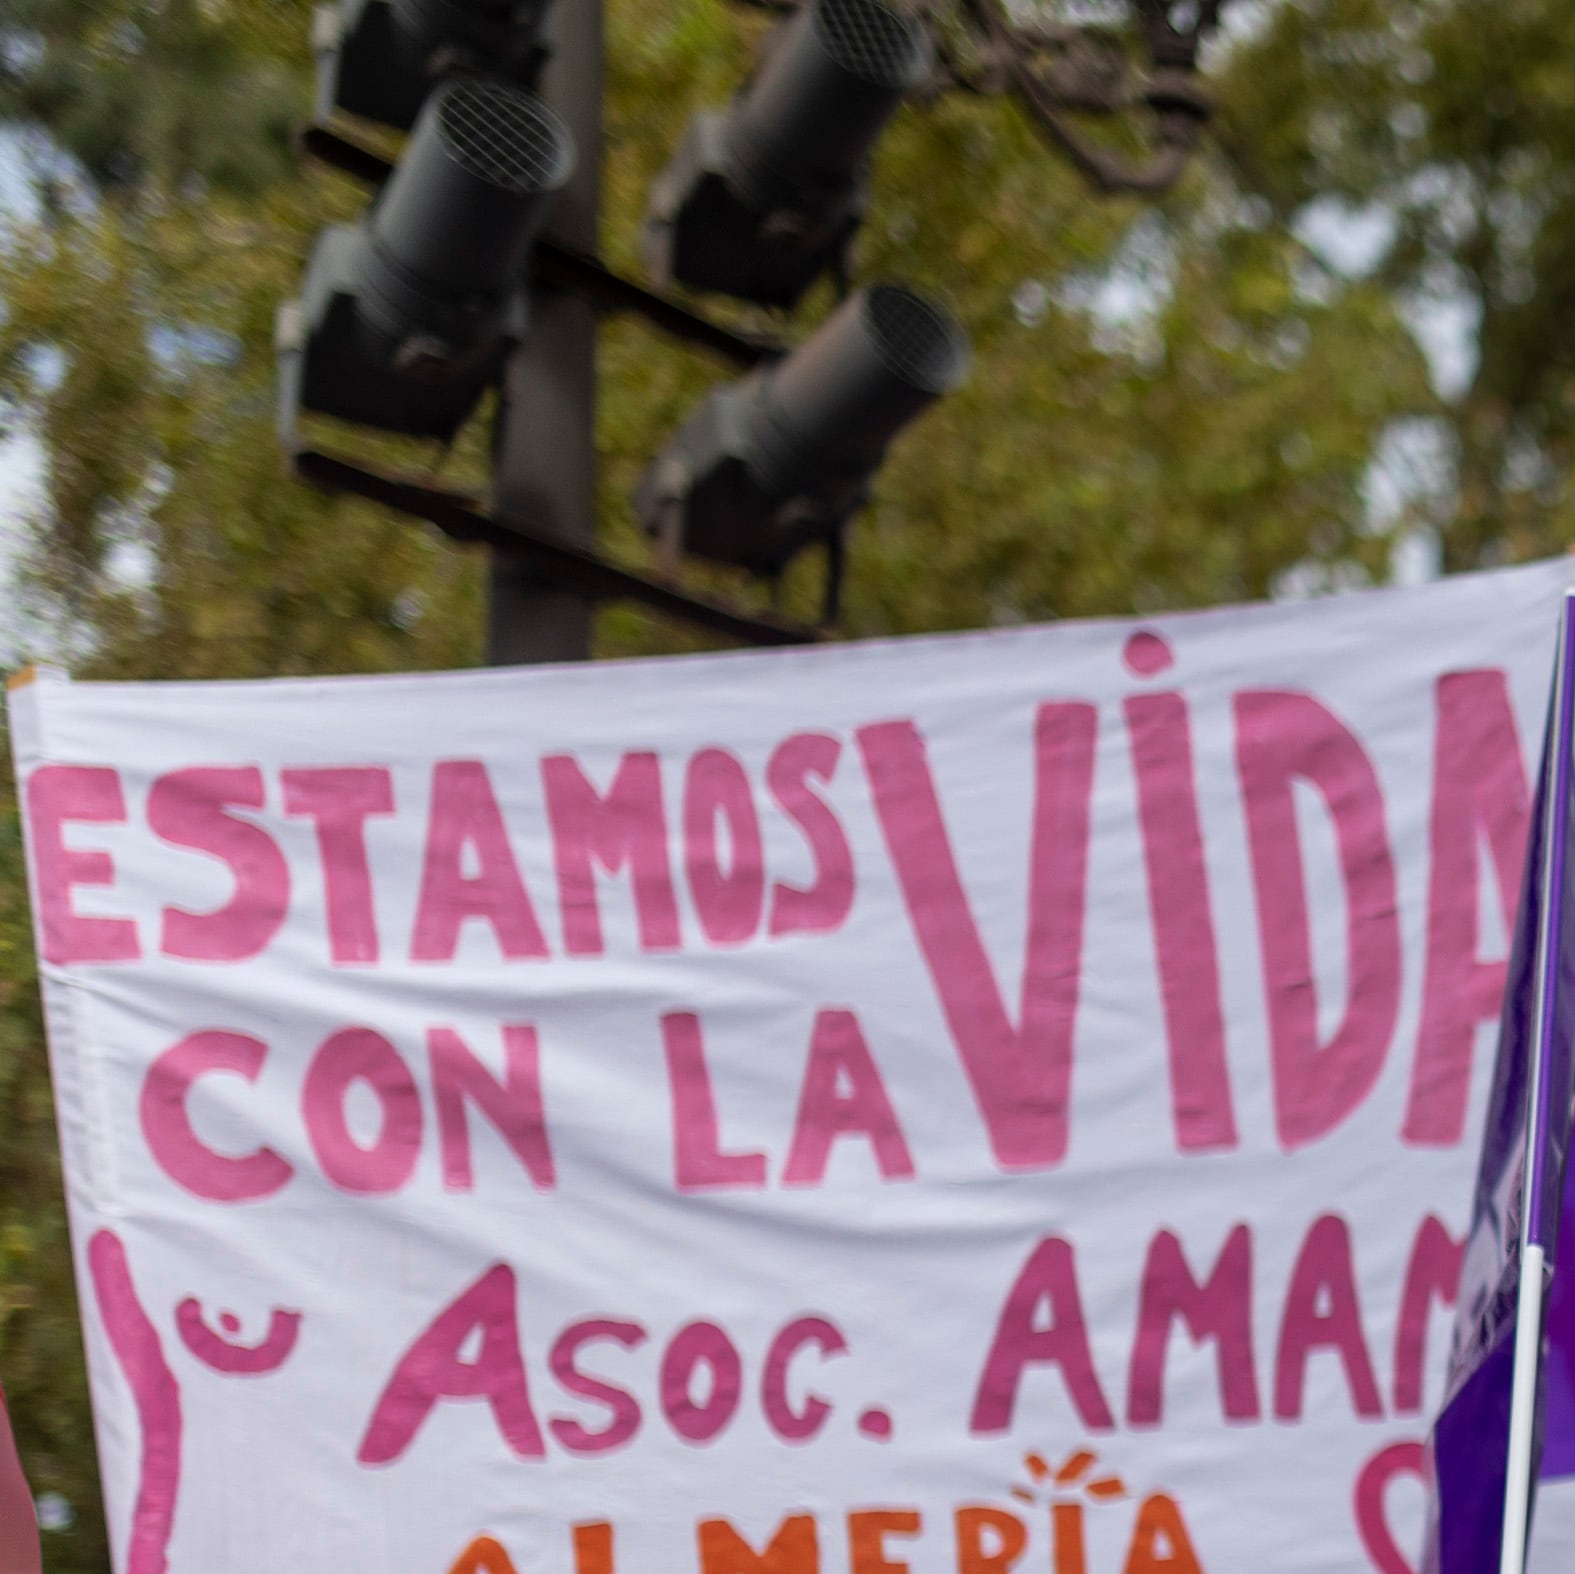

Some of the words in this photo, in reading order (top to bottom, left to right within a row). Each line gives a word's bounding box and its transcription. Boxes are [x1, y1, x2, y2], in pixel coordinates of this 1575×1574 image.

[26, 731, 857, 967] ESTAMOS
[139, 1025, 557, 1203] CON
[661, 1007, 917, 1194] LA
